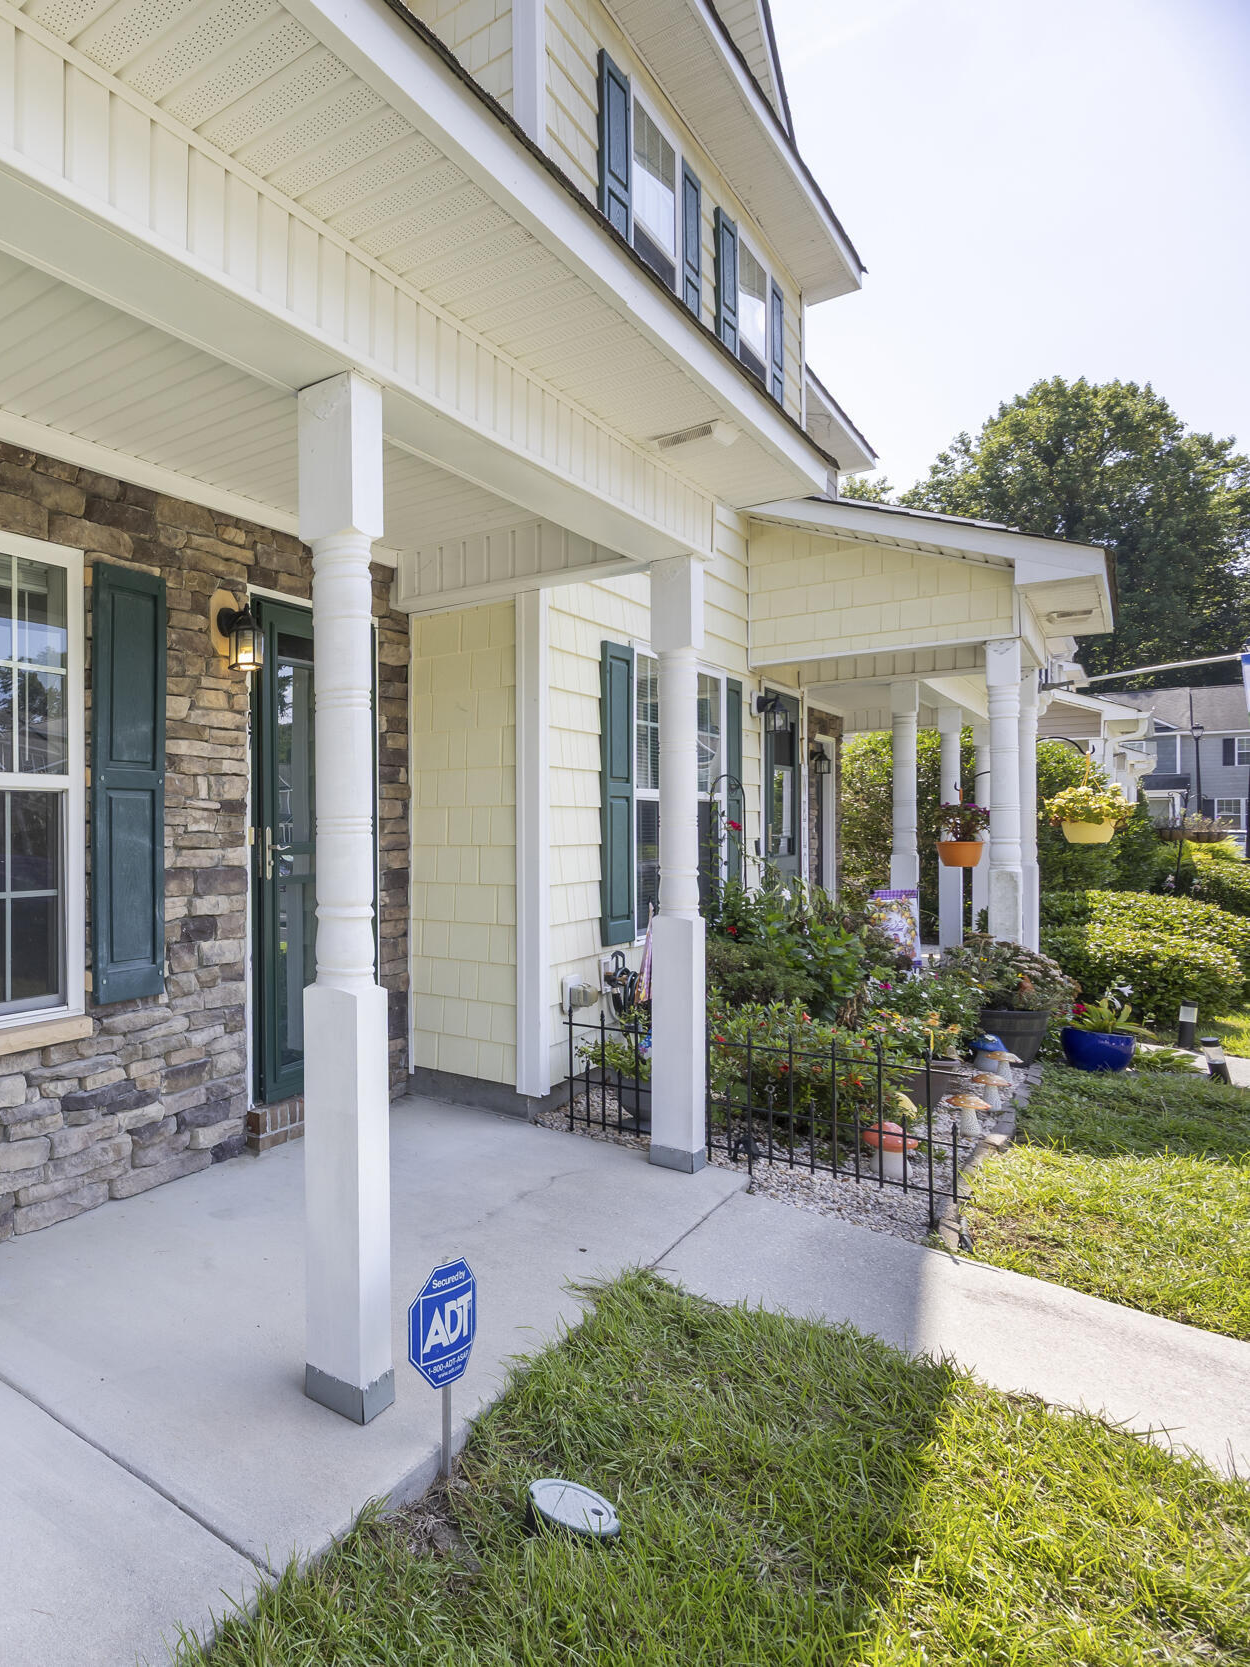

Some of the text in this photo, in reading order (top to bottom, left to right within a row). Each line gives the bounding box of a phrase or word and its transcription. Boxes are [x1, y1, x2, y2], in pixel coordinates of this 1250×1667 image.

[432, 1270, 466, 1289] Secured by
[422, 1290, 472, 1354] ADT
[427, 1349, 469, 1375] 1-800-ADT-ASAP
